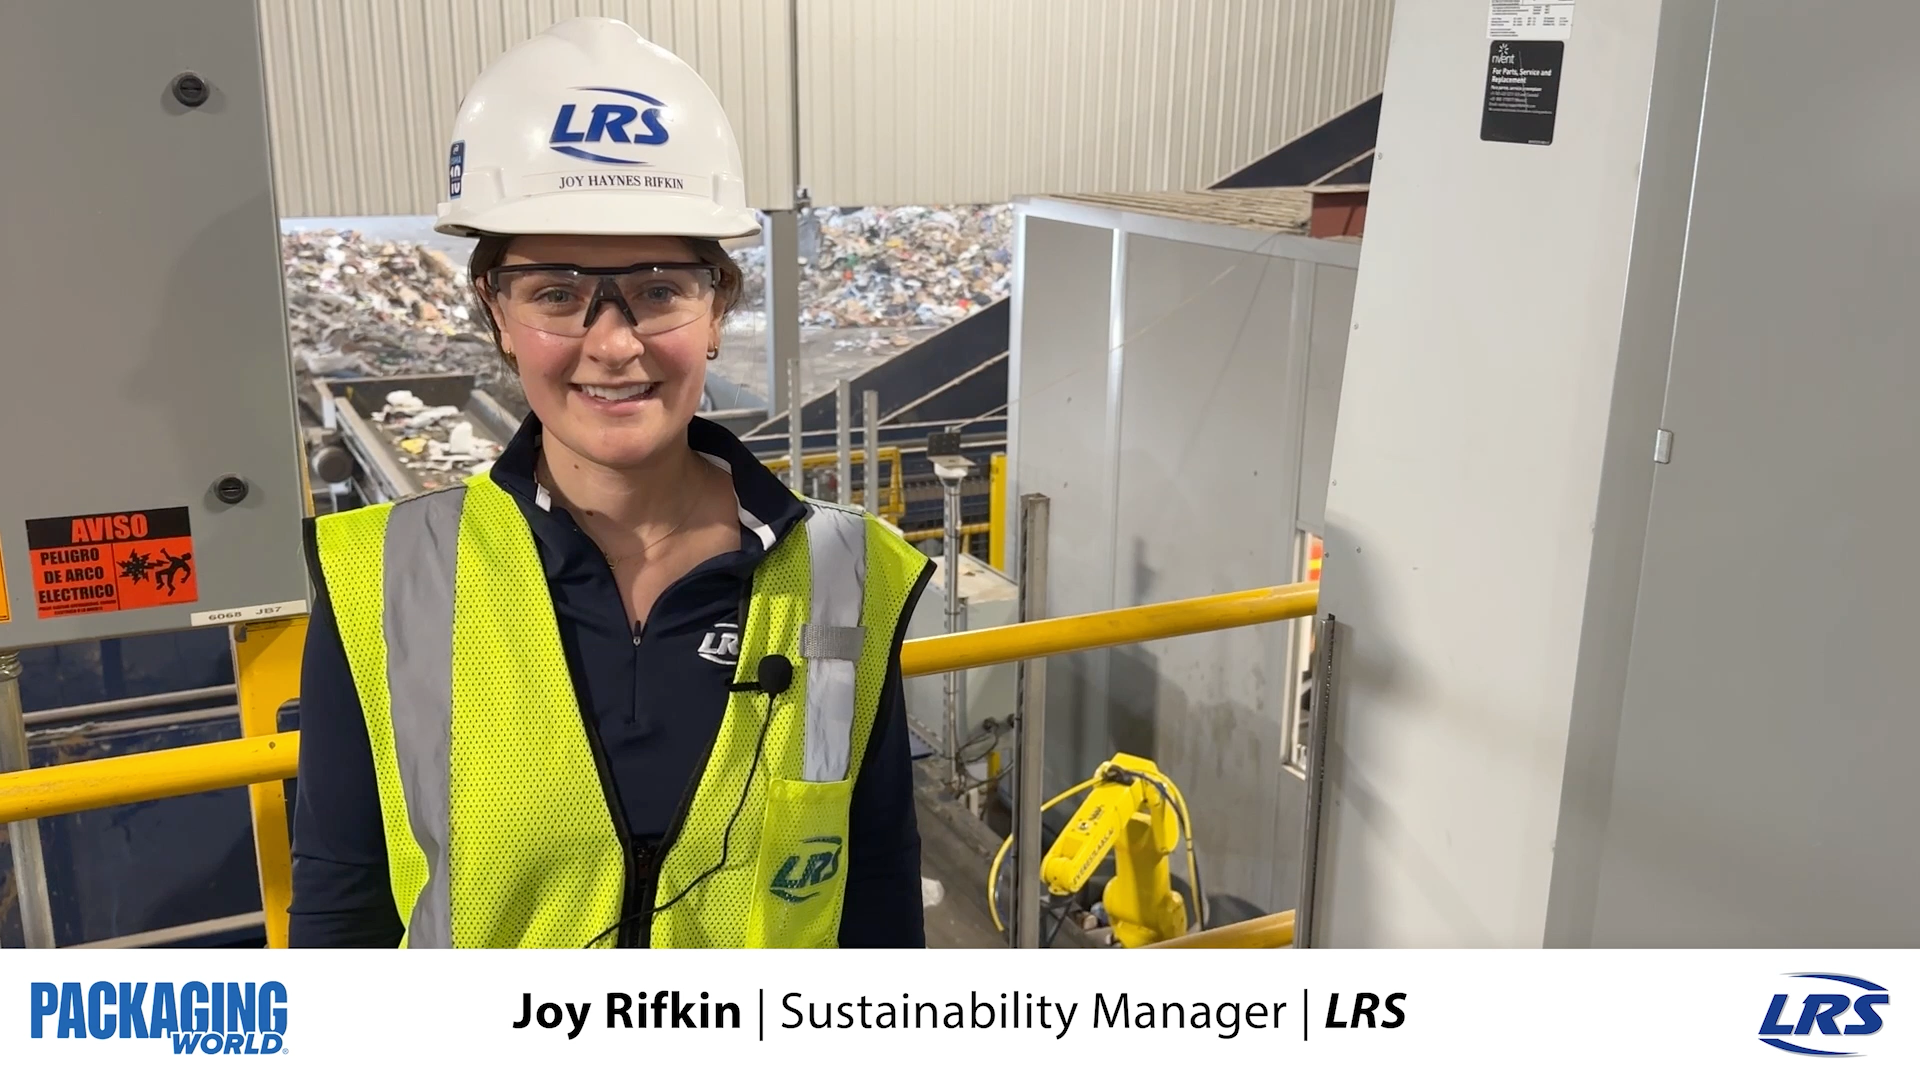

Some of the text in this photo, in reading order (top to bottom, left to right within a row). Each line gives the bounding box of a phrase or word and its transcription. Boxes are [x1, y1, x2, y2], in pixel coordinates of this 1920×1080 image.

[1492, 67, 1502, 75] For
[1519, 68, 1540, 76] Service
[549, 103, 670, 146] LRS
[559, 175, 684, 190] JOY HAYNES RIFKIN
[71, 513, 148, 543] AVISO
[40, 547, 100, 566] PELIGRO
[44, 566, 104, 585] DE ARCO
[38, 583, 114, 604] ELECTRICO
[255, 606, 282, 615] JB7
[697, 632, 739, 655] LR
